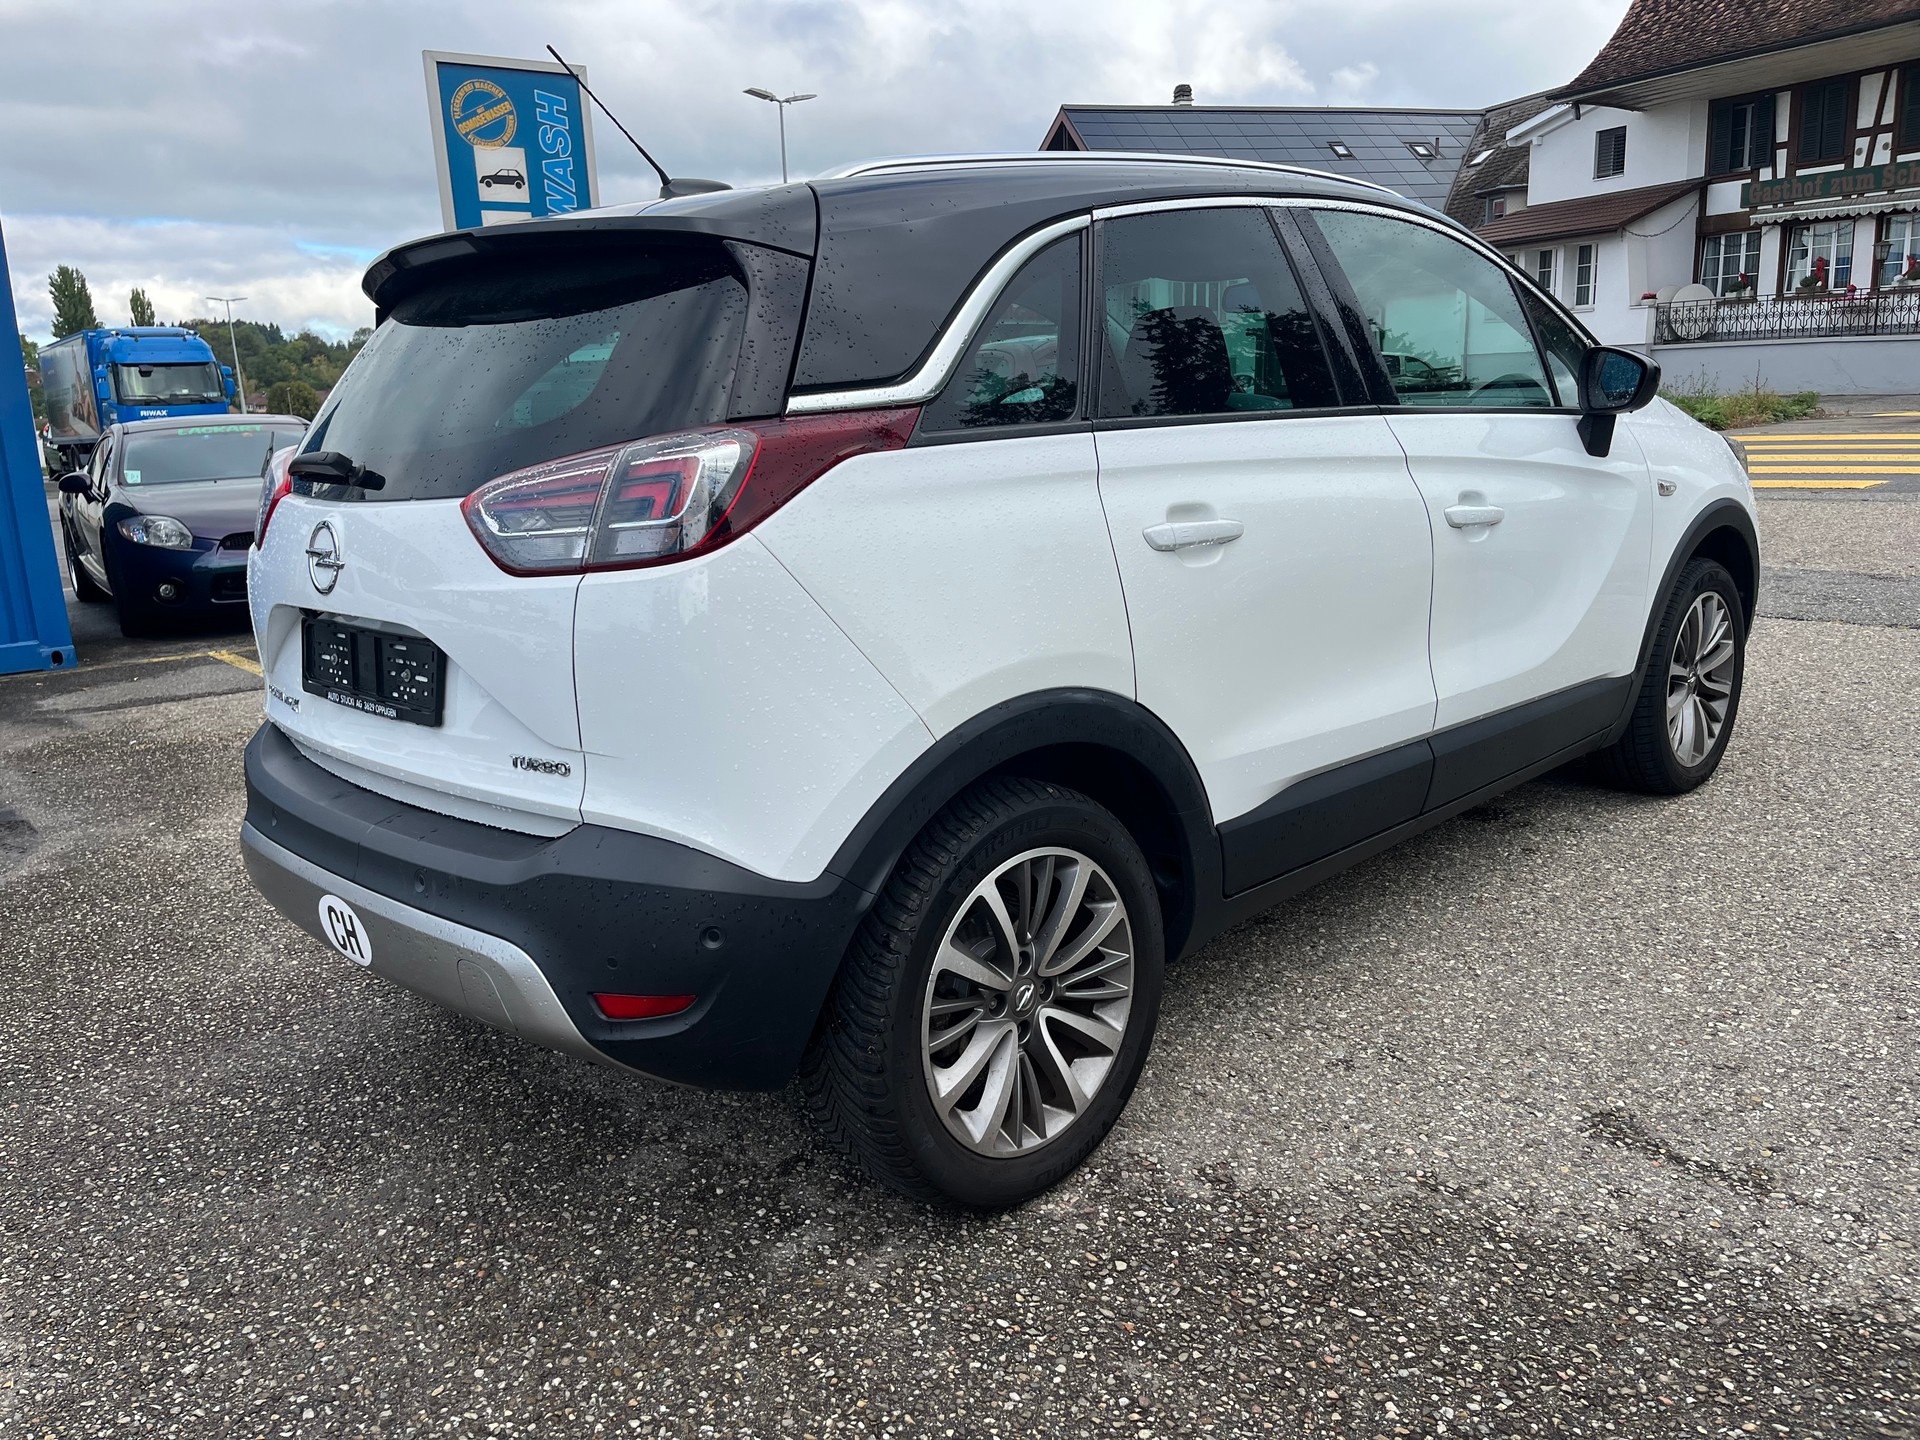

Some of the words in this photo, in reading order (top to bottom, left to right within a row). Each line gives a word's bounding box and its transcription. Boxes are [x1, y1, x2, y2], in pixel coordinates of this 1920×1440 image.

[474, 81, 505, 98] WASCHEN
[458, 100, 513, 134] OSMOSEWASSER
[1750, 176, 1824, 202] Gasthof
[1831, 172, 1875, 194] zum
[140, 409, 168, 417] RIWAX
[177, 424, 263, 436] LACKART
[328, 691, 340, 702] AUTO
[340, 694, 355, 706] STUCKI
[356, 699, 363, 708] AG
[363, 701, 375, 711] 3629
[509, 755, 571, 777] TURBO
[327, 904, 366, 960] CH
